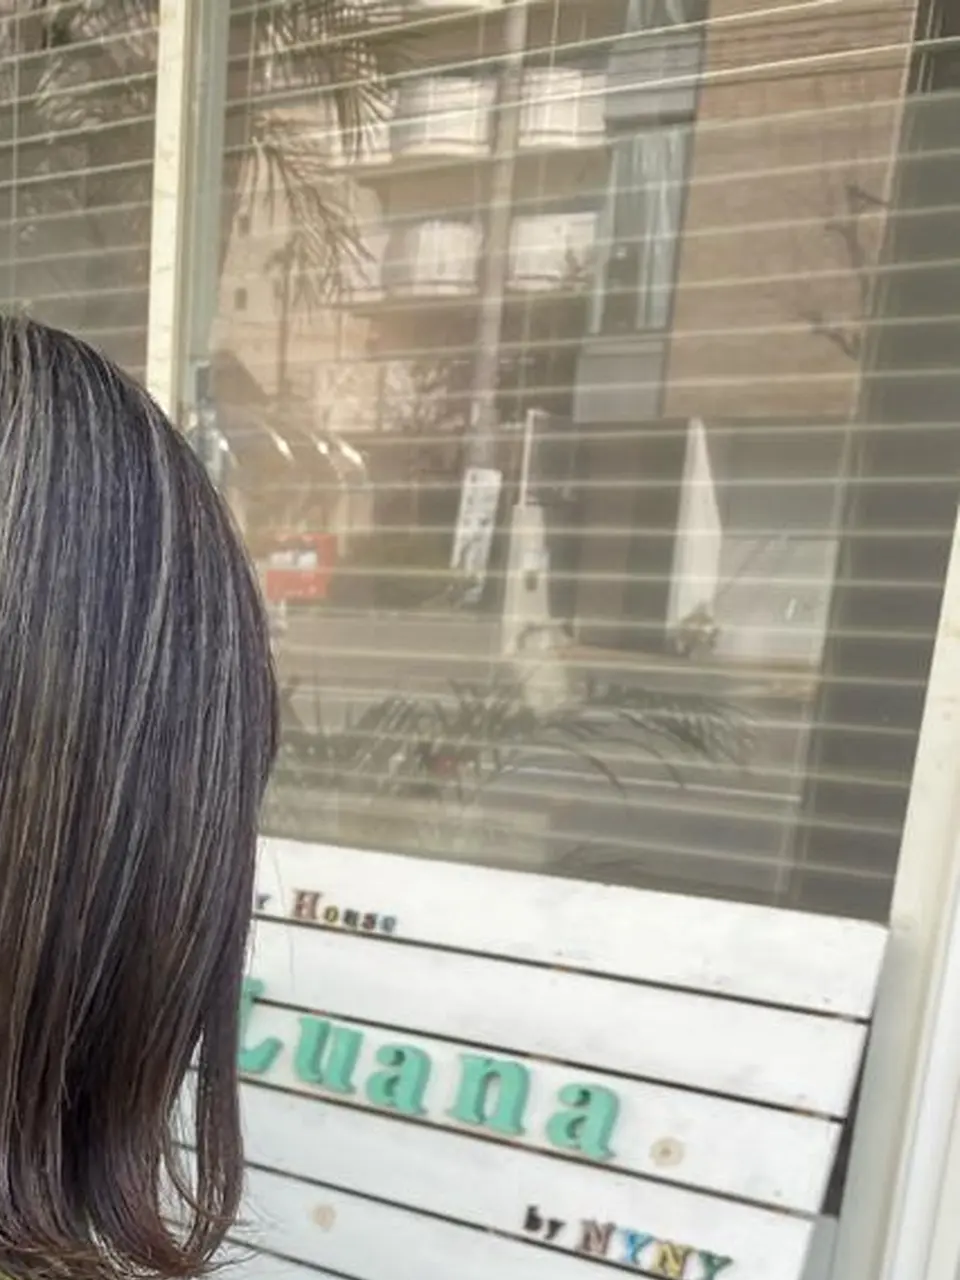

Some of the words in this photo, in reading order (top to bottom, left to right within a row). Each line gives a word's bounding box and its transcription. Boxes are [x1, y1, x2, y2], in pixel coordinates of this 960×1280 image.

[292, 888, 396, 933] House
[237, 977, 620, 1161] Luana
[524, 1204, 566, 1241] by
